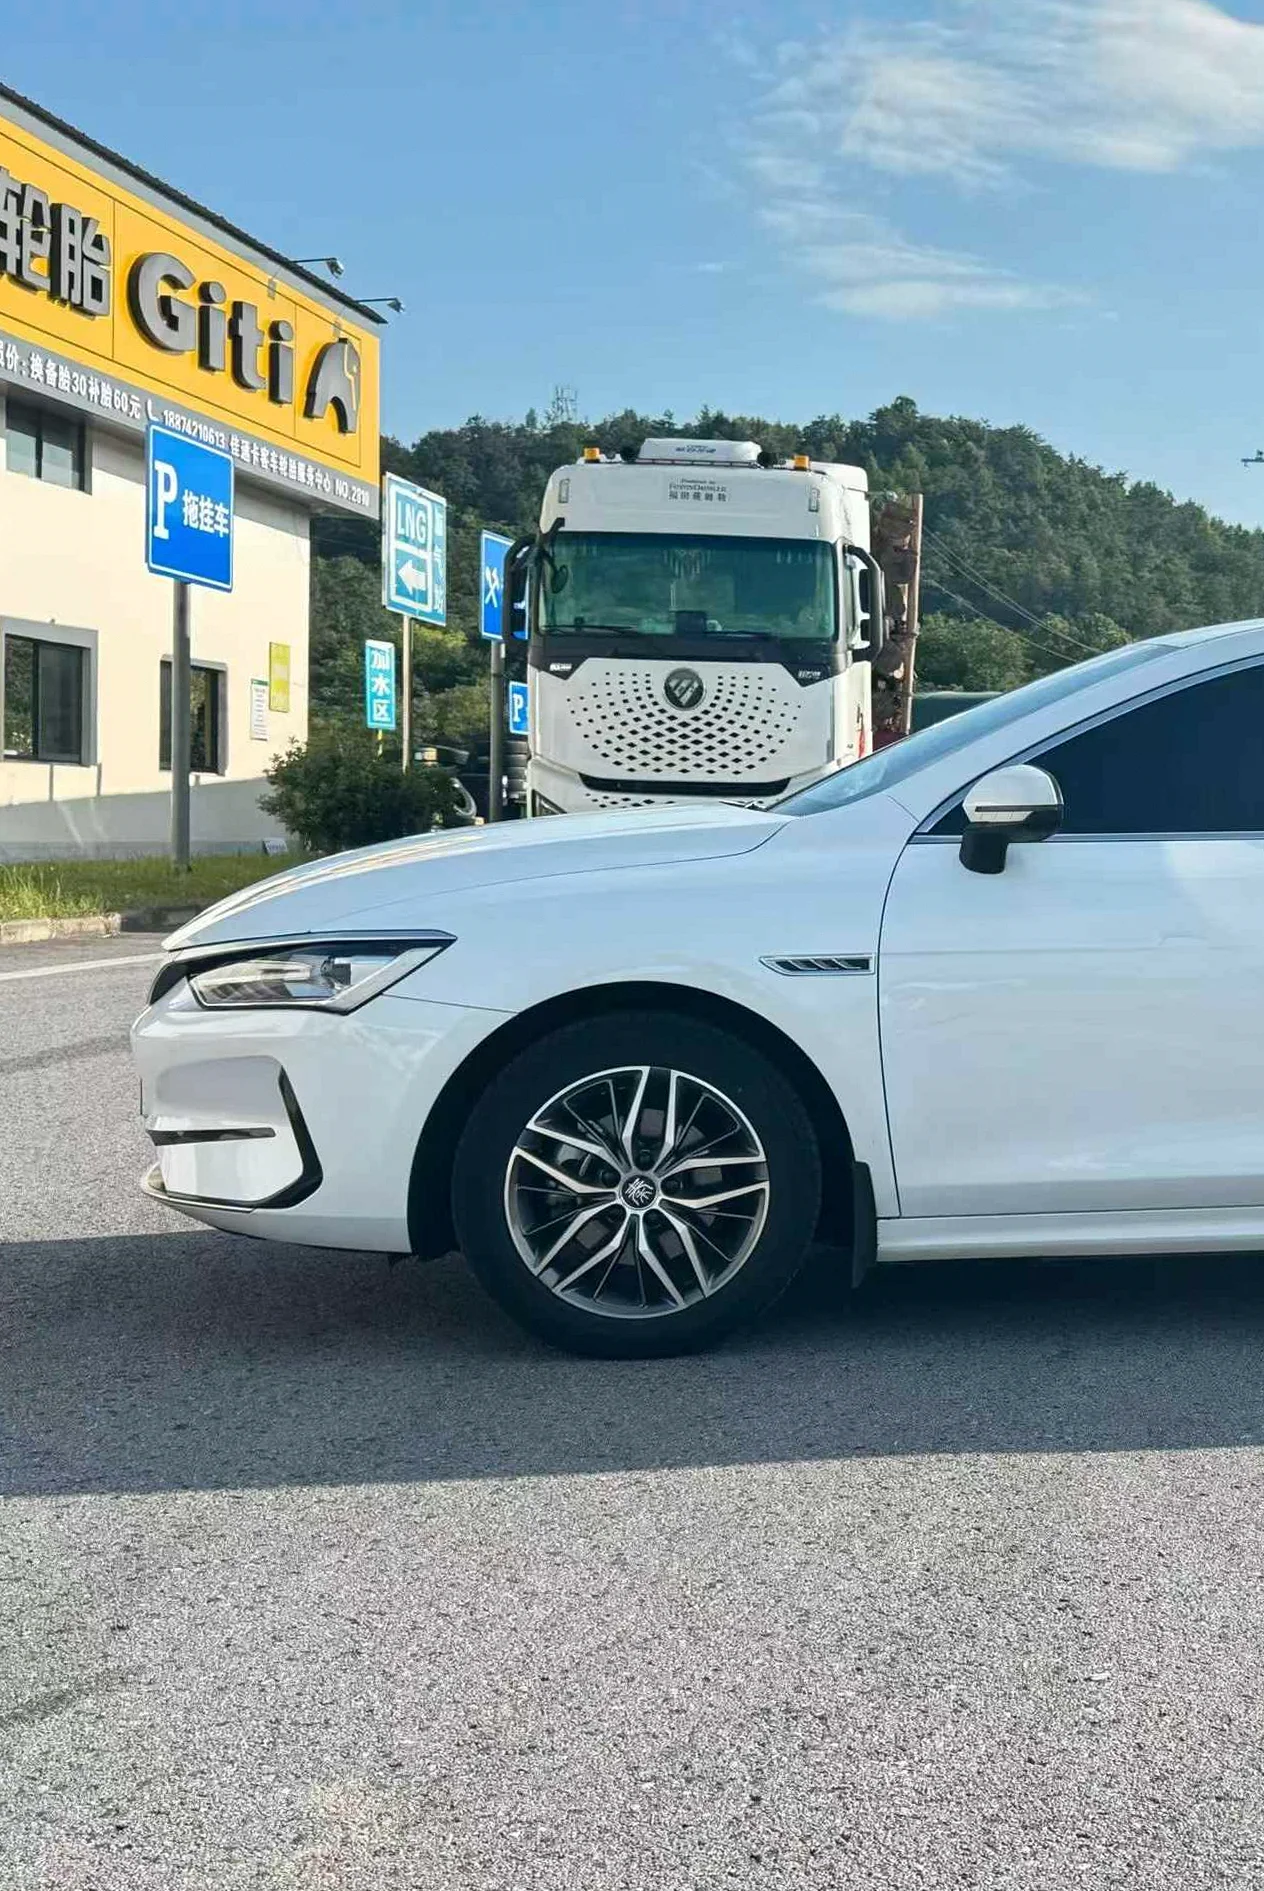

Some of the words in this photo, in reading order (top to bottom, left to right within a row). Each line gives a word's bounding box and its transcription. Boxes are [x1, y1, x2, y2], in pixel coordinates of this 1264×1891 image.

[0, 166, 111, 317] 轮胎
[153, 460, 178, 539] P
[182, 489, 230, 538] 拖挂车
[397, 500, 427, 544] LNG
[370, 647, 391, 722] 加水区
[513, 693, 524, 722] P
